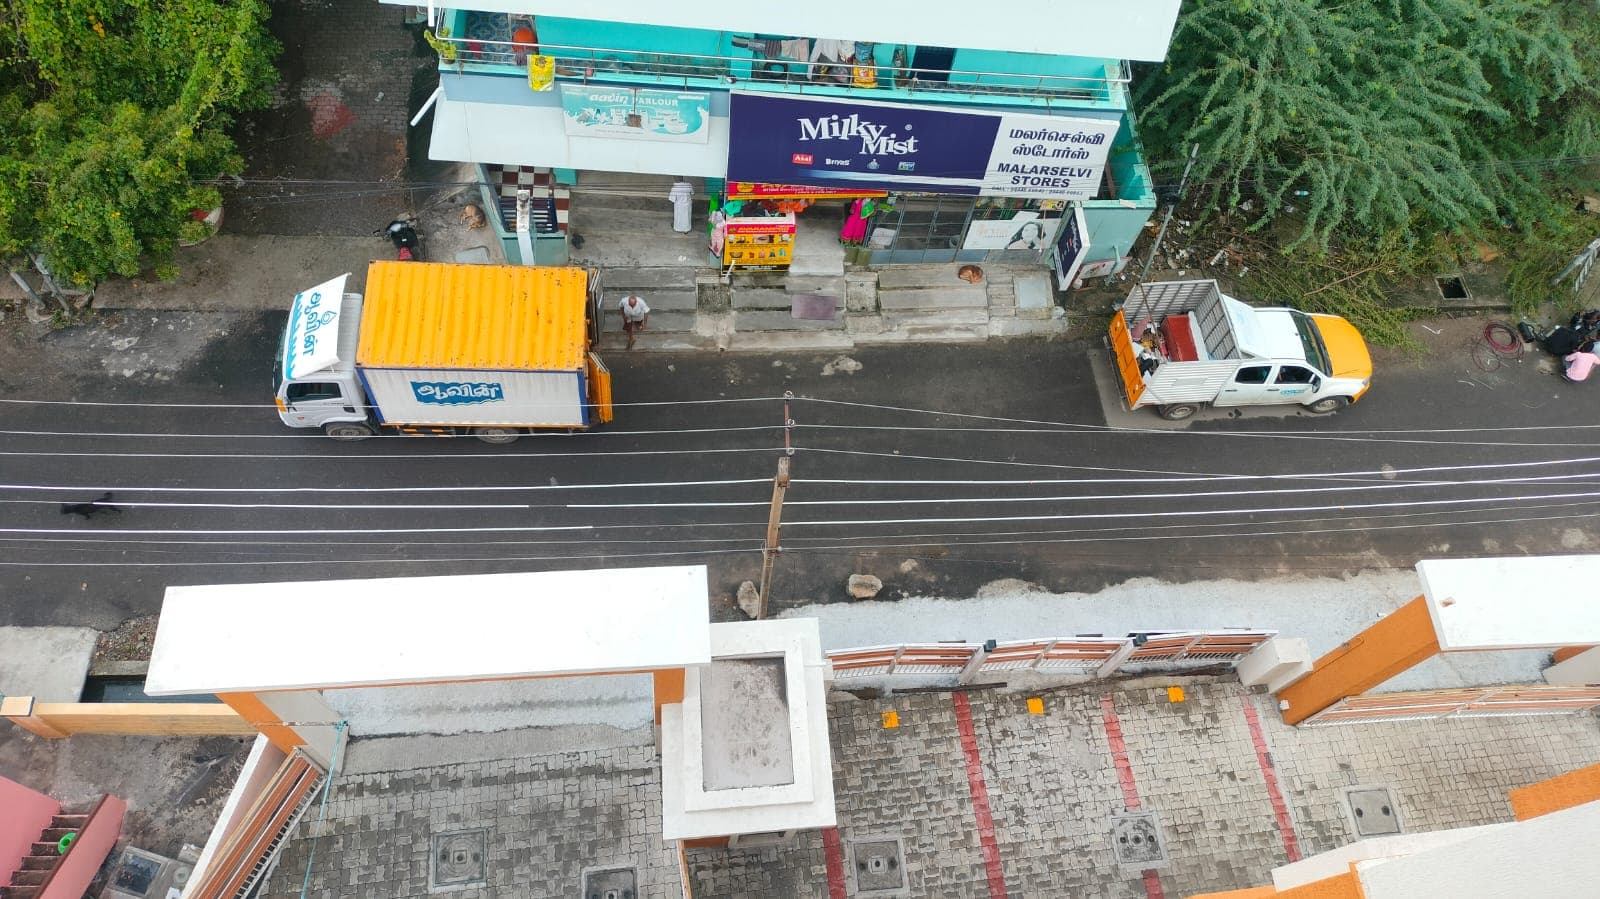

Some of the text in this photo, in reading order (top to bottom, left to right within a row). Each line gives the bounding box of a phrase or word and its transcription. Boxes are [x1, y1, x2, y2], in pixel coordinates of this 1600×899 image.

[797, 114, 886, 143] Milky
[1009, 128, 1105, 145] மலர்செல்வி
[859, 133, 919, 155] Mist
[1012, 143, 1090, 160] ஸ்டோர்ஸ்
[997, 163, 1092, 178] MALARSELVI
[1011, 176, 1071, 188] STORES
[303, 292, 322, 356] ஆவின்
[418, 384, 500, 400] ஆவின்
